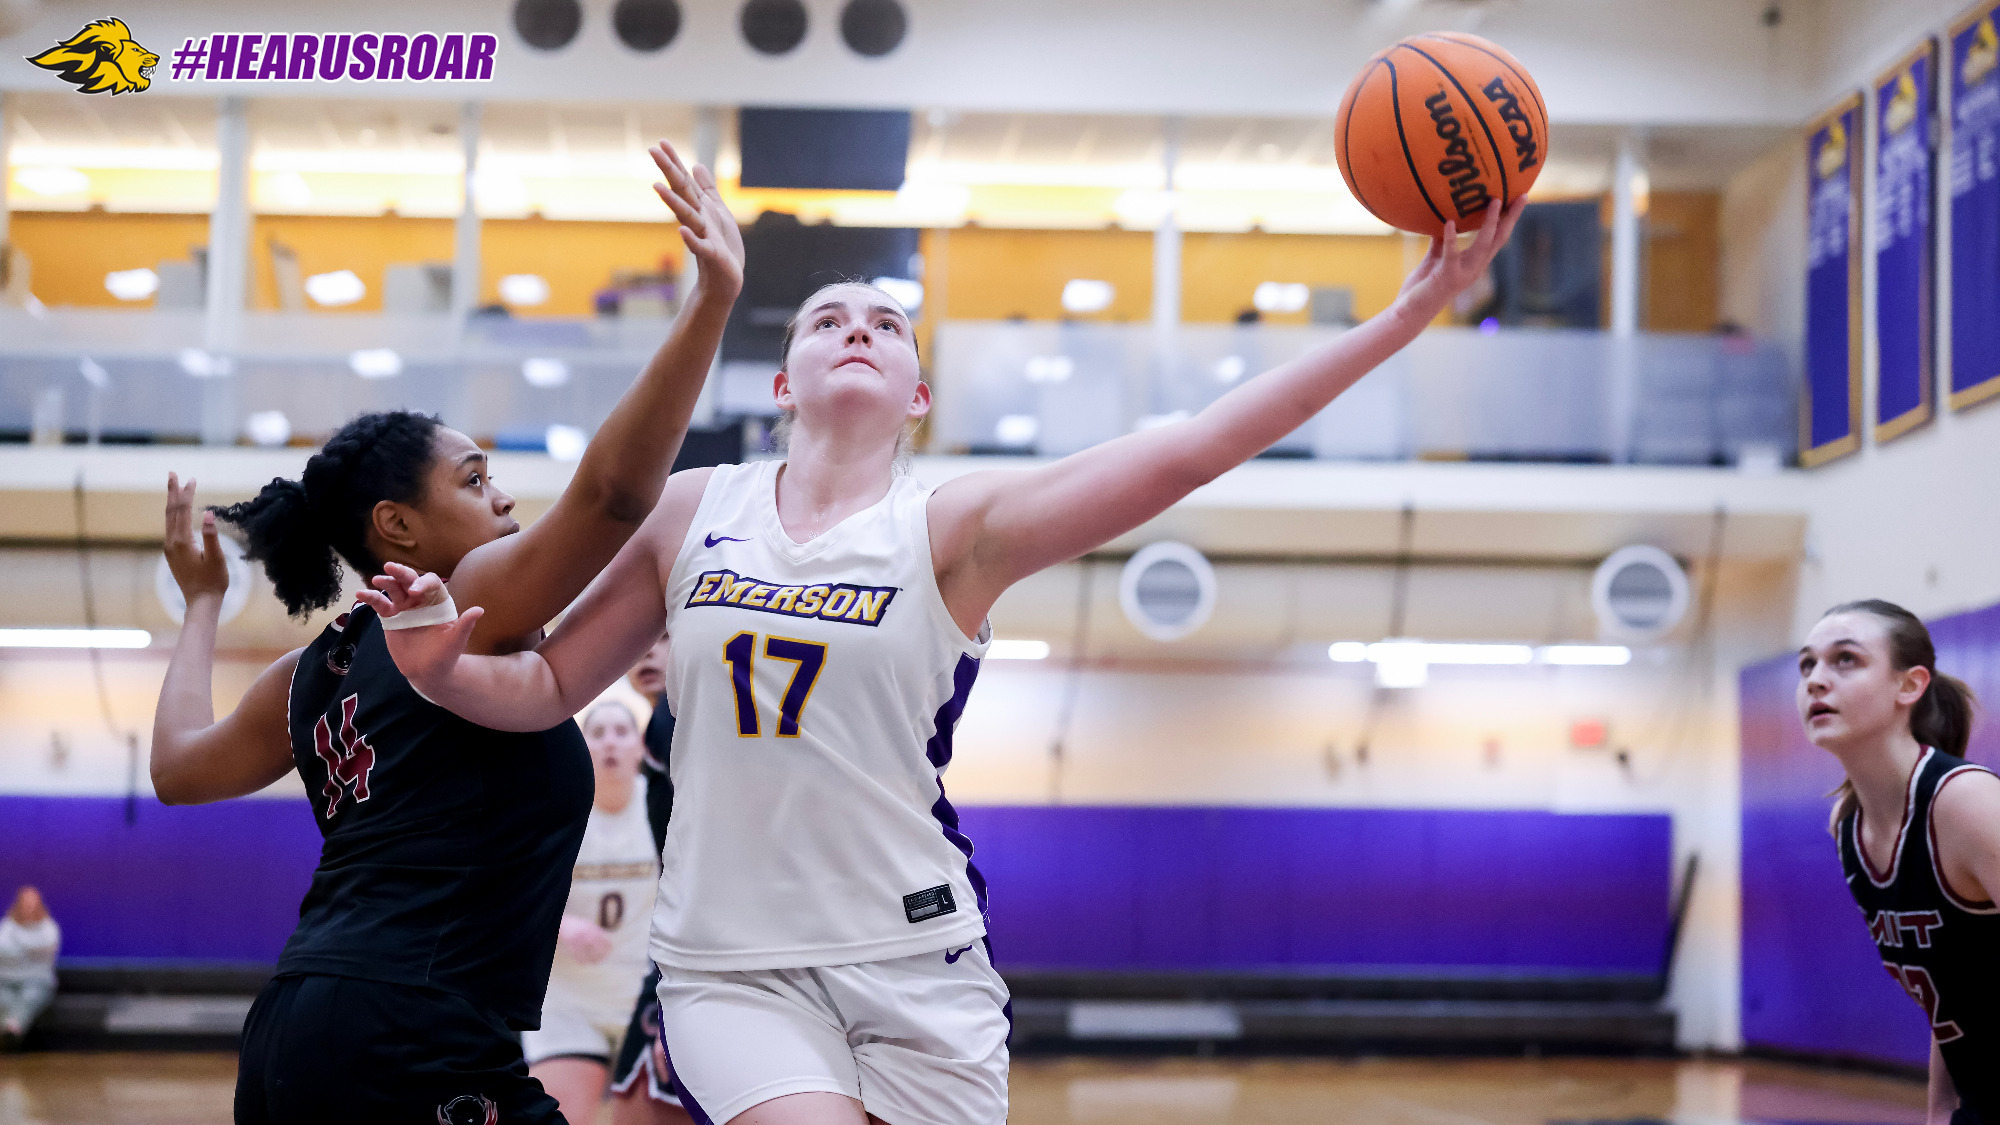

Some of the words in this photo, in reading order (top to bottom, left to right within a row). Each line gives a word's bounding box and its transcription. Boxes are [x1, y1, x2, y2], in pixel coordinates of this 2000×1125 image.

[1424, 89, 1493, 219] Wilson
[1482, 76, 1538, 173] NCAA
[688, 571, 892, 623] EMERSON
[722, 630, 829, 738] 17
[313, 692, 376, 820] 14
[598, 892, 624, 931] 0
[941, 894, 949, 905] L
[1881, 960, 1964, 1044] 2
